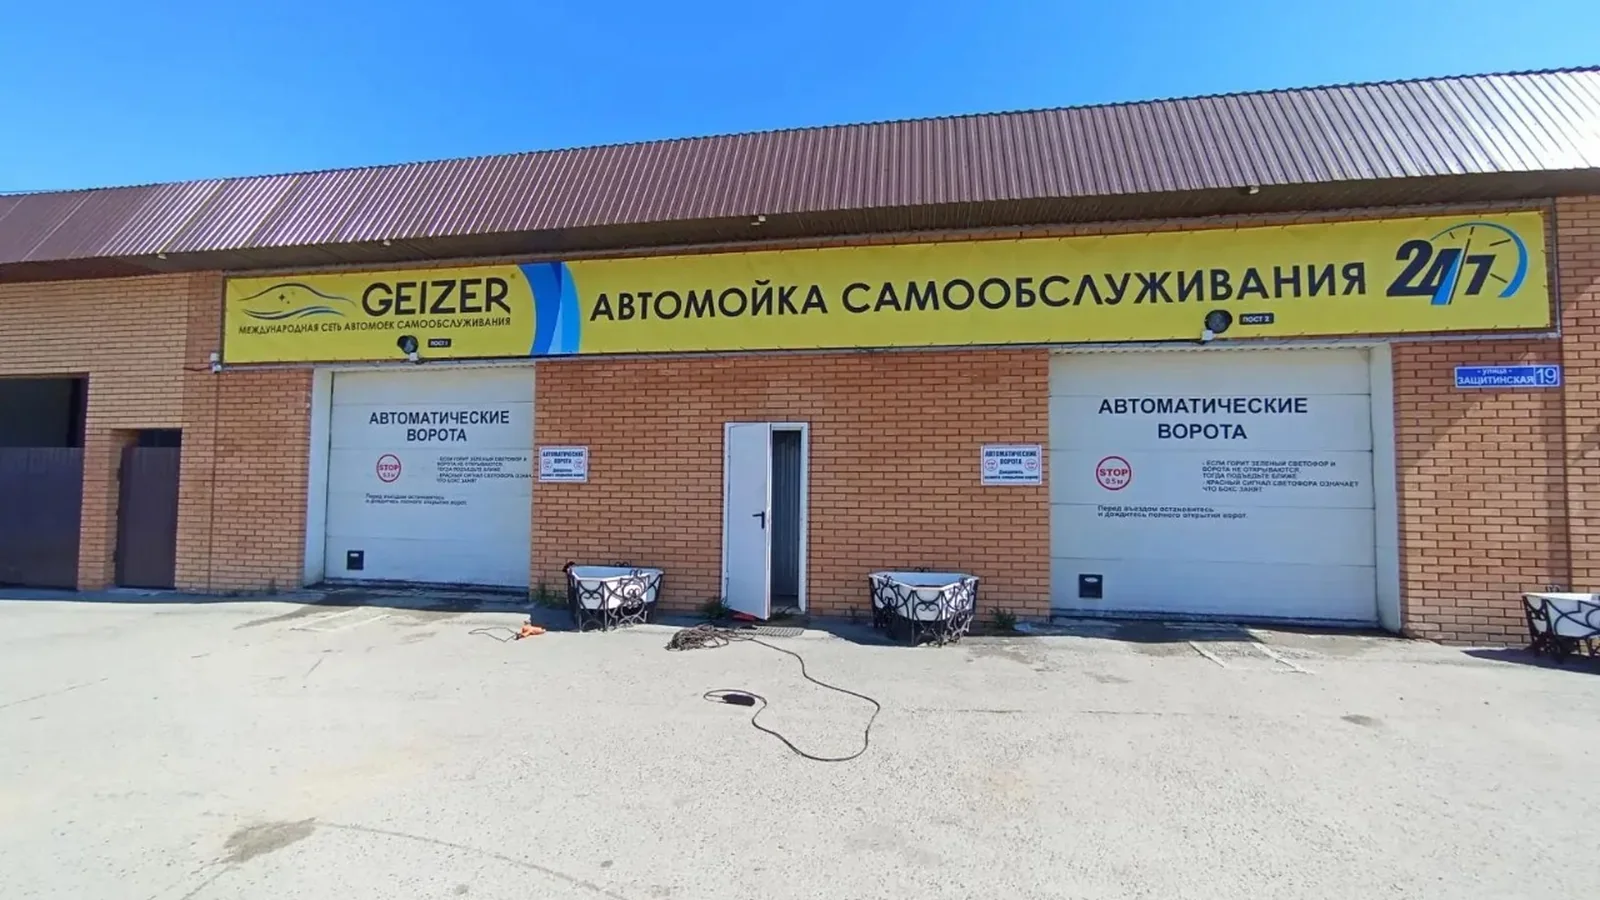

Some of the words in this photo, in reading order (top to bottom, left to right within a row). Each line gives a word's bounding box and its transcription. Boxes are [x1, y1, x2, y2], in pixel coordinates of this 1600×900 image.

[361, 276, 511, 316] GEIZER
[590, 279, 828, 322] АВТОМОЙКА
[842, 262, 1367, 313] САМООБСЛУЖИВАНИЯ
[238, 323, 318, 334] МЕЖДУНАРОДНАЯ
[321, 322, 342, 332] СЕТЬ
[344, 320, 395, 331] АВТОМОЕК
[397, 317, 511, 330] САМООБСЛУЖИВАНИЯ
[1458, 375, 1535, 385] ЗАЩИТИНСКАЯ
[1536, 368, 1557, 384] 19
[1098, 397, 1308, 414] АВТОМАТИЧЕСКИЕ
[369, 410, 510, 425] АВТОМАТИЧЕСКИЕ
[406, 428, 467, 442] ВОРОТА
[1158, 423, 1248, 440] ВОРОТА
[1099, 468, 1129, 477] STOP
